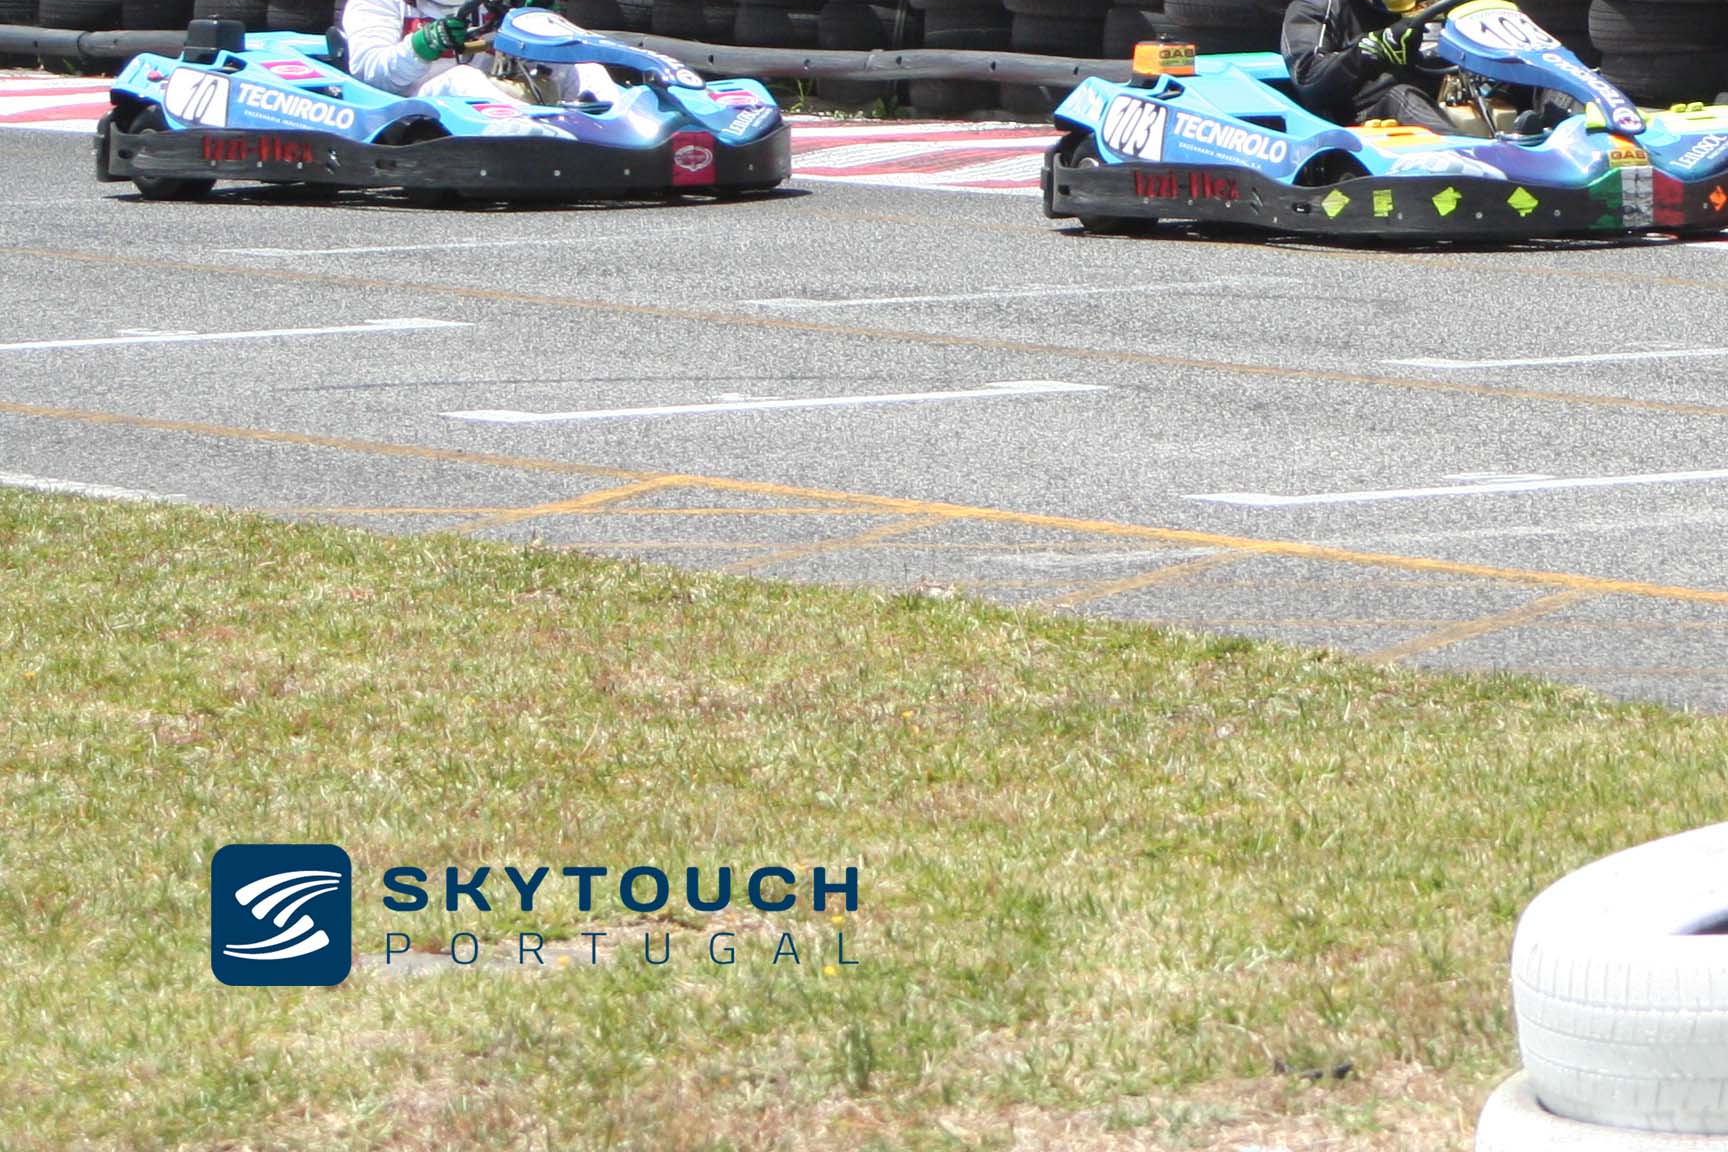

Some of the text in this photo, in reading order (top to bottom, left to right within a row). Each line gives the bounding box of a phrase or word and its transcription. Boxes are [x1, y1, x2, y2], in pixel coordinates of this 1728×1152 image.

[1480, 17, 1554, 45] 103
[181, 72, 355, 130] 10 TECNIROLO
[1173, 111, 1288, 164] TECNIROLO
